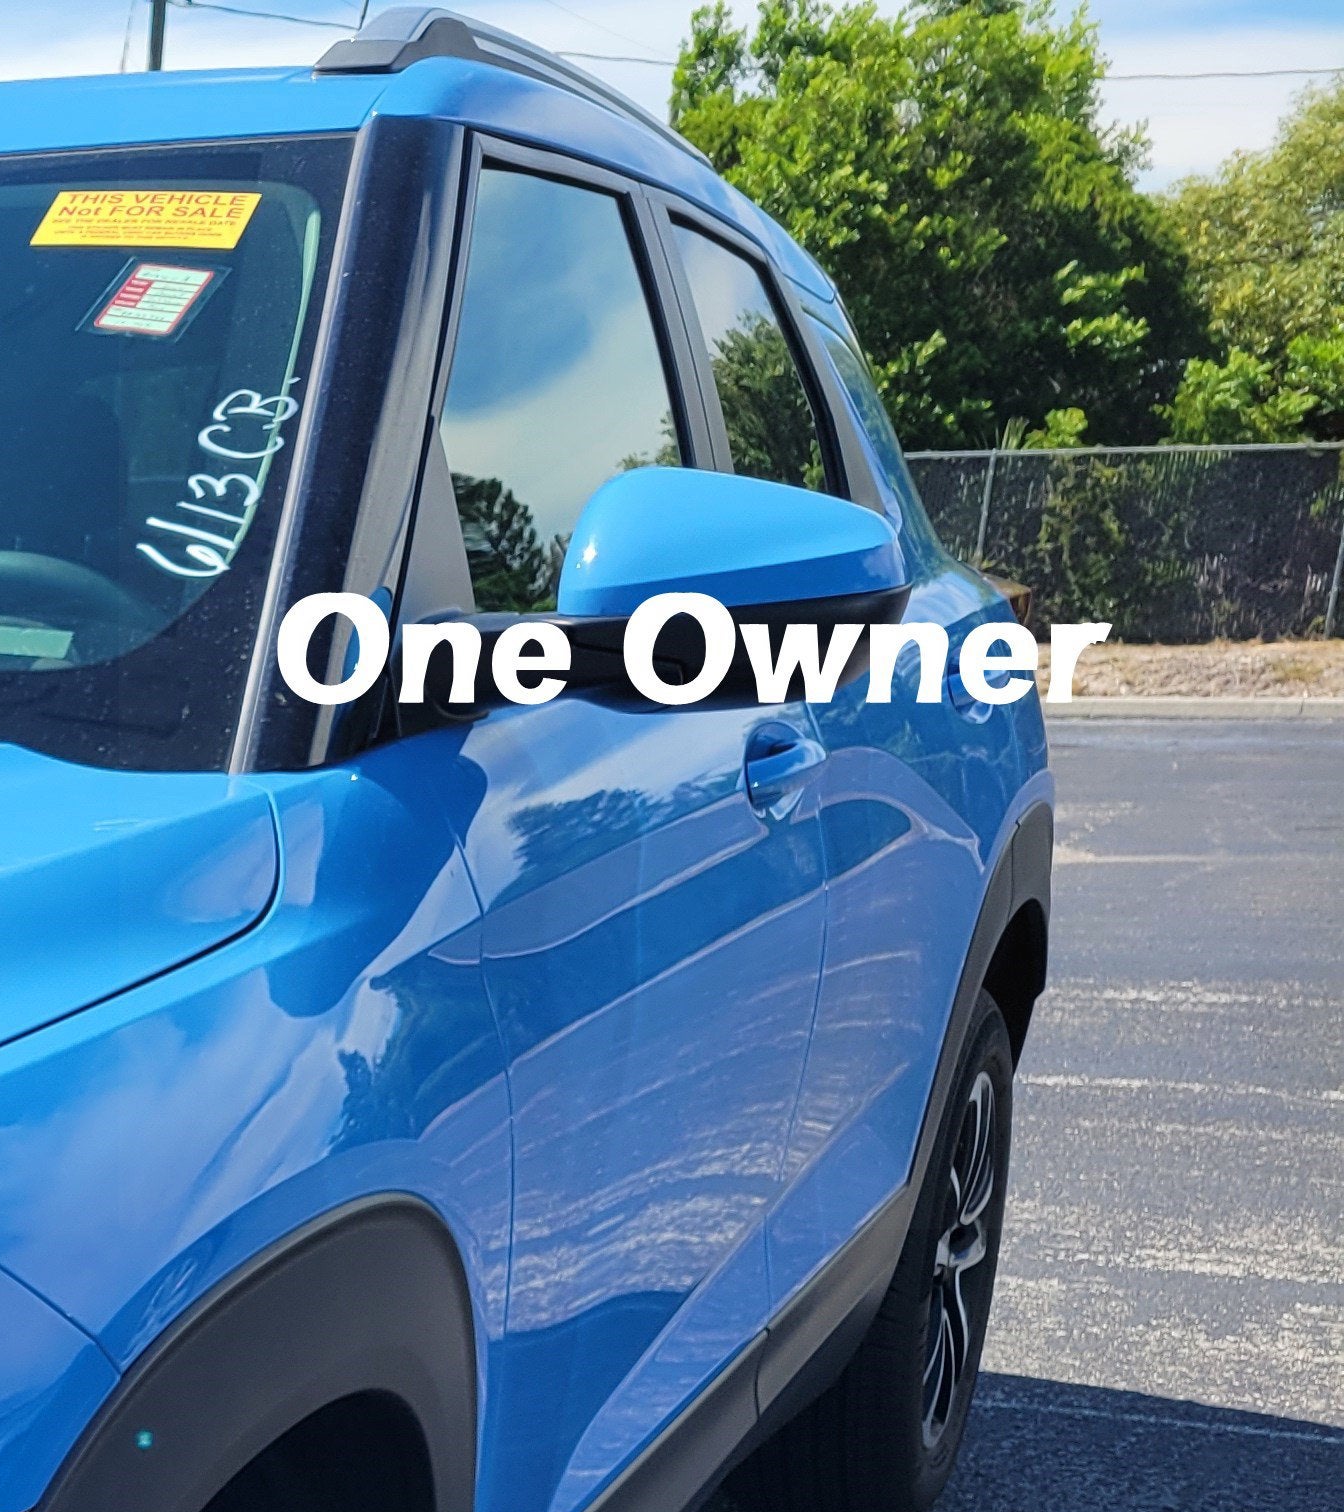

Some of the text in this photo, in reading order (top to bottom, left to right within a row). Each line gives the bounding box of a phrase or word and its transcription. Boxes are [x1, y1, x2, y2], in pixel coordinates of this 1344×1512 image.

[69, 193, 249, 207] THIS VEHICLE
[58, 205, 245, 219] Not FOR SALE
